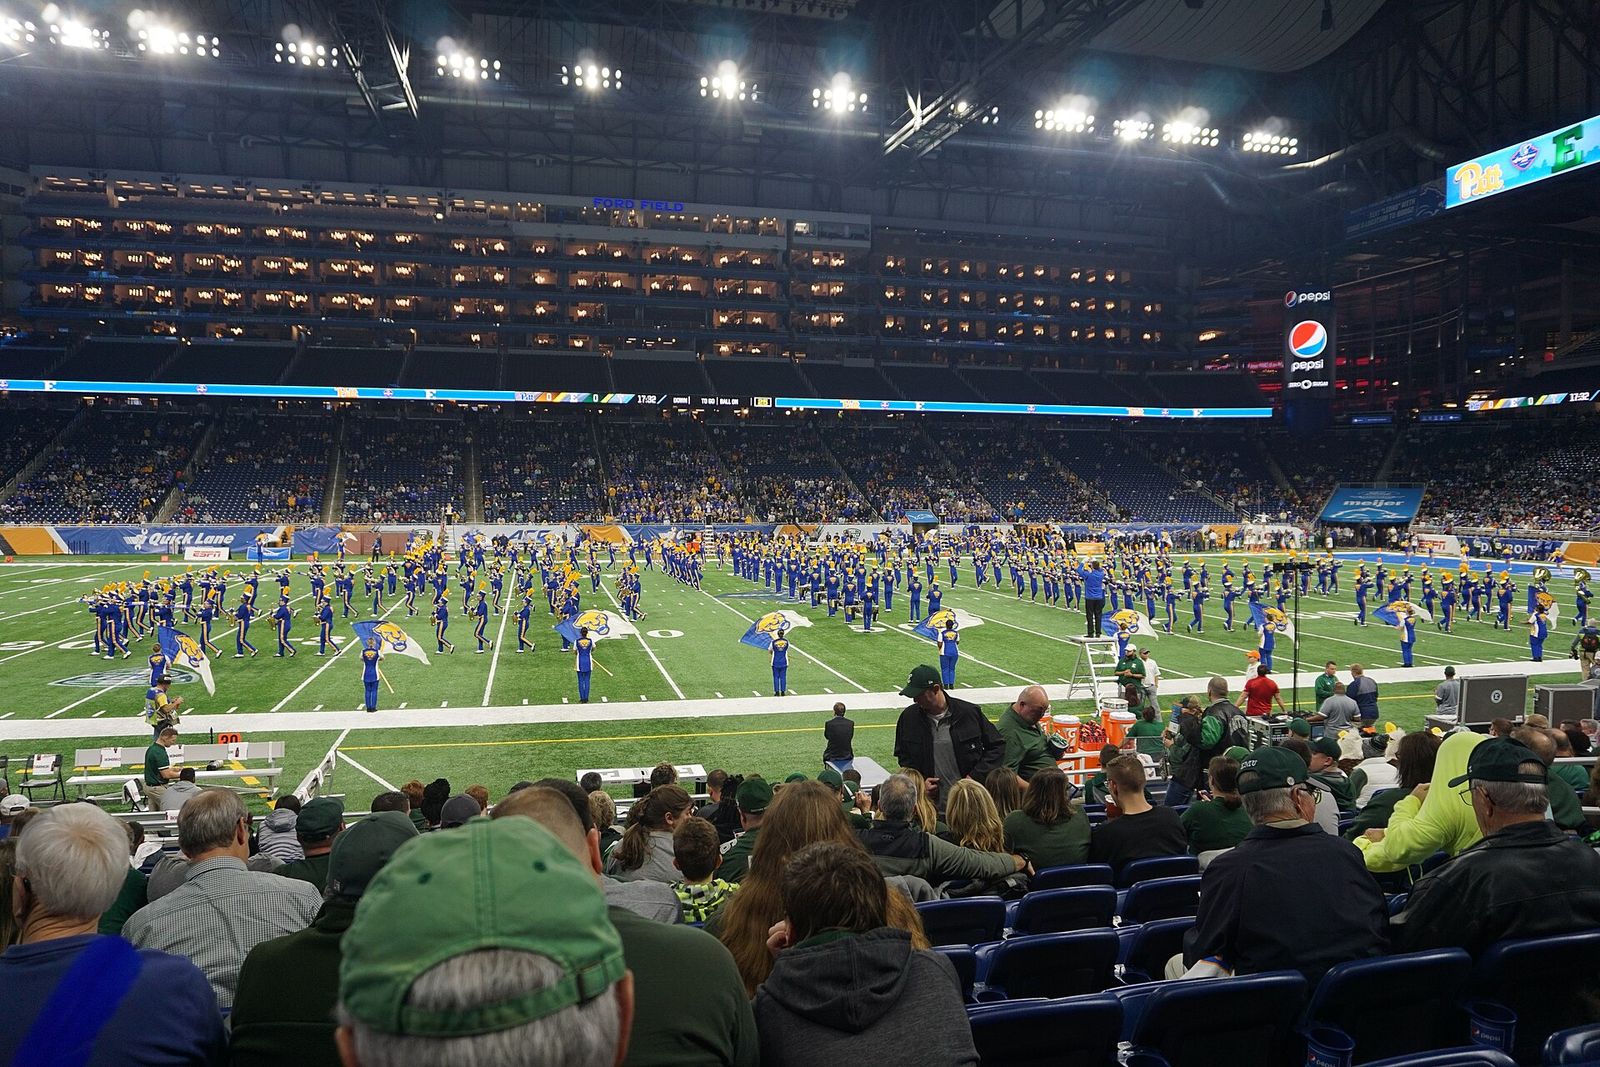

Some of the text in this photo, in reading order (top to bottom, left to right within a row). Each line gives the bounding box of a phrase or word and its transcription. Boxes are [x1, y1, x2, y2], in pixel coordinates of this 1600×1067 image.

[1454, 123, 1584, 200] Pitt E
[593, 197, 684, 212] FORD FIELD
[1298, 291, 1330, 303] pepsi
[1291, 359, 1324, 372] pepsi
[546, 393, 552, 401] 0
[593, 394, 598, 403] 0
[637, 395, 657, 404] 17:32
[1569, 392, 1590, 402] 17:32
[1343, 499, 1405, 507] meijer
[149, 532, 234, 546] Quick Lane
[192, 550, 222, 558] ESPN
[1240, 759, 1258, 770] EMU
